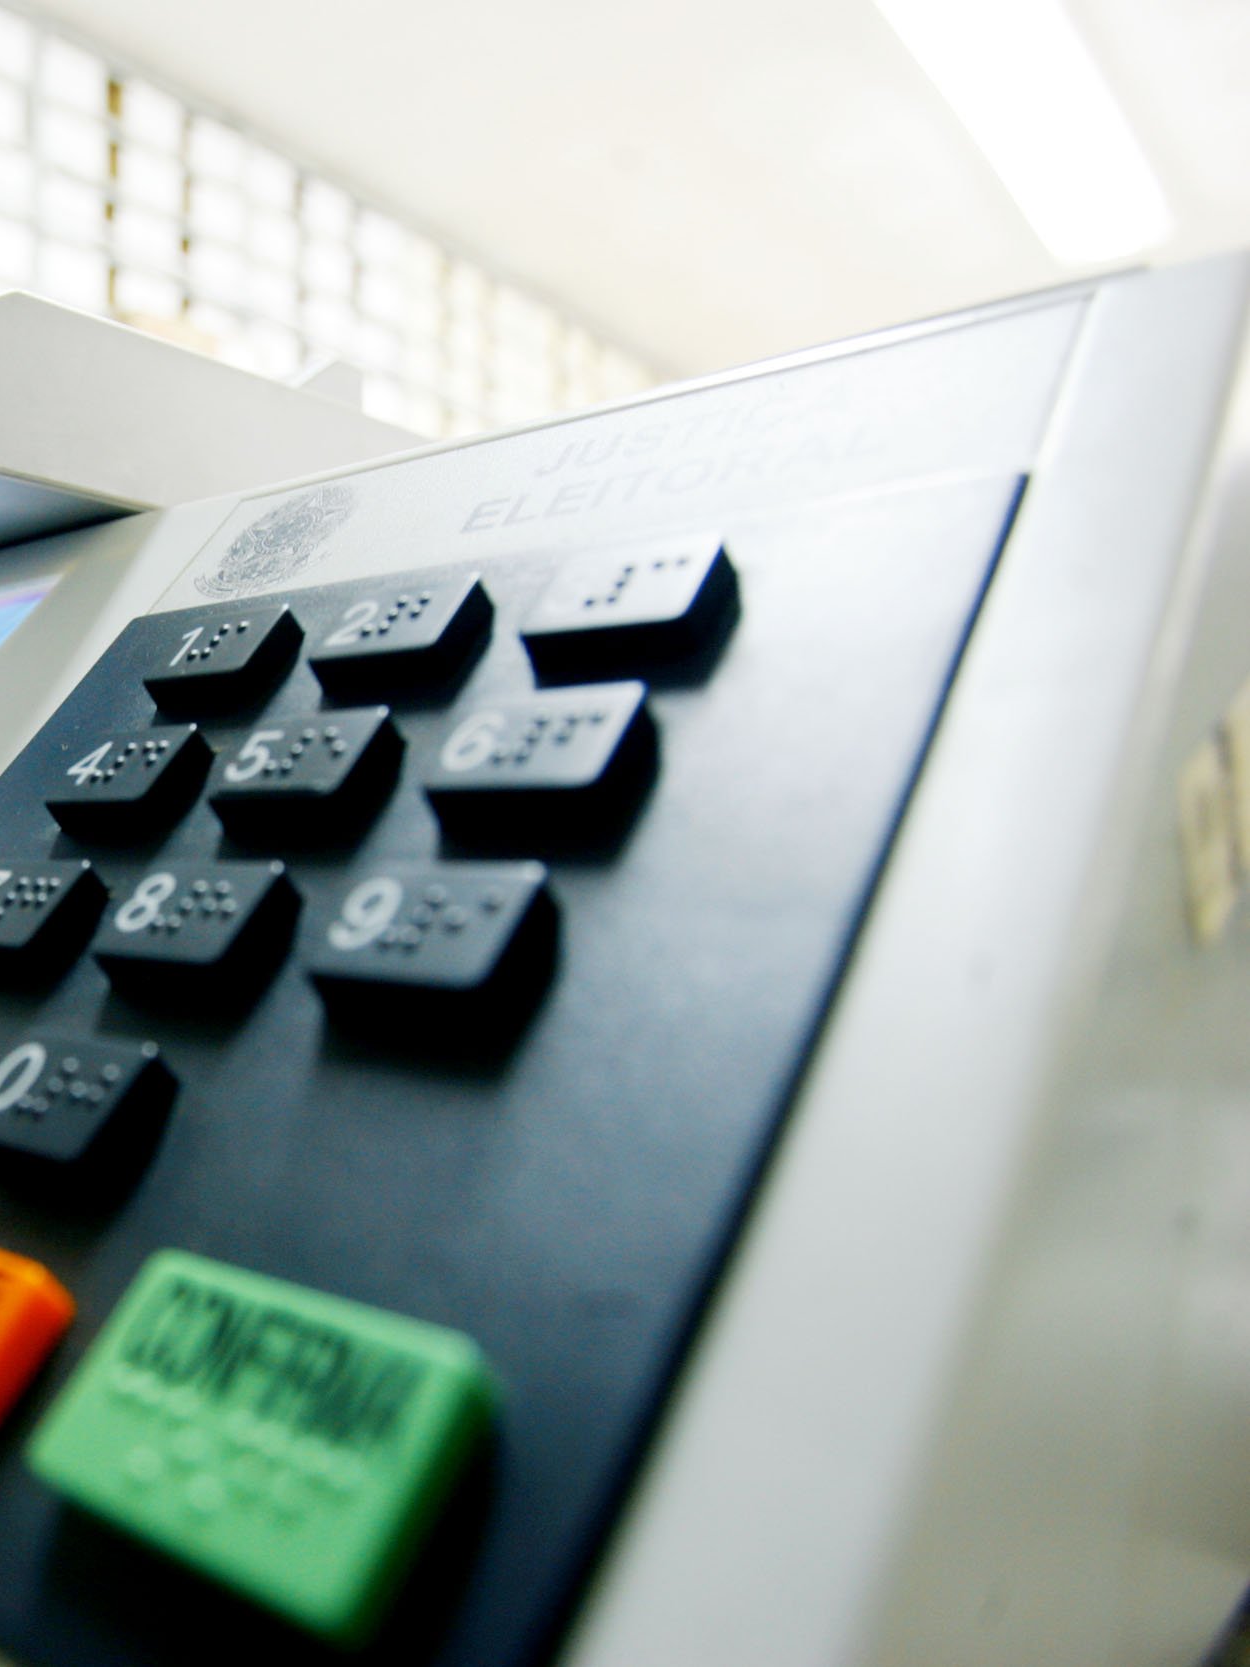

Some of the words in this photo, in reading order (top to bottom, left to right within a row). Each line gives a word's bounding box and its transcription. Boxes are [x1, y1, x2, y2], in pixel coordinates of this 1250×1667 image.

[459, 424, 887, 535] ELEITORAL
[169, 626, 205, 667] 1
[323, 601, 378, 647] 2
[66, 741, 113, 786] 4
[224, 729, 285, 783] 5
[440, 711, 505, 772] 6
[114, 873, 177, 932] 8
[328, 877, 403, 950] 9
